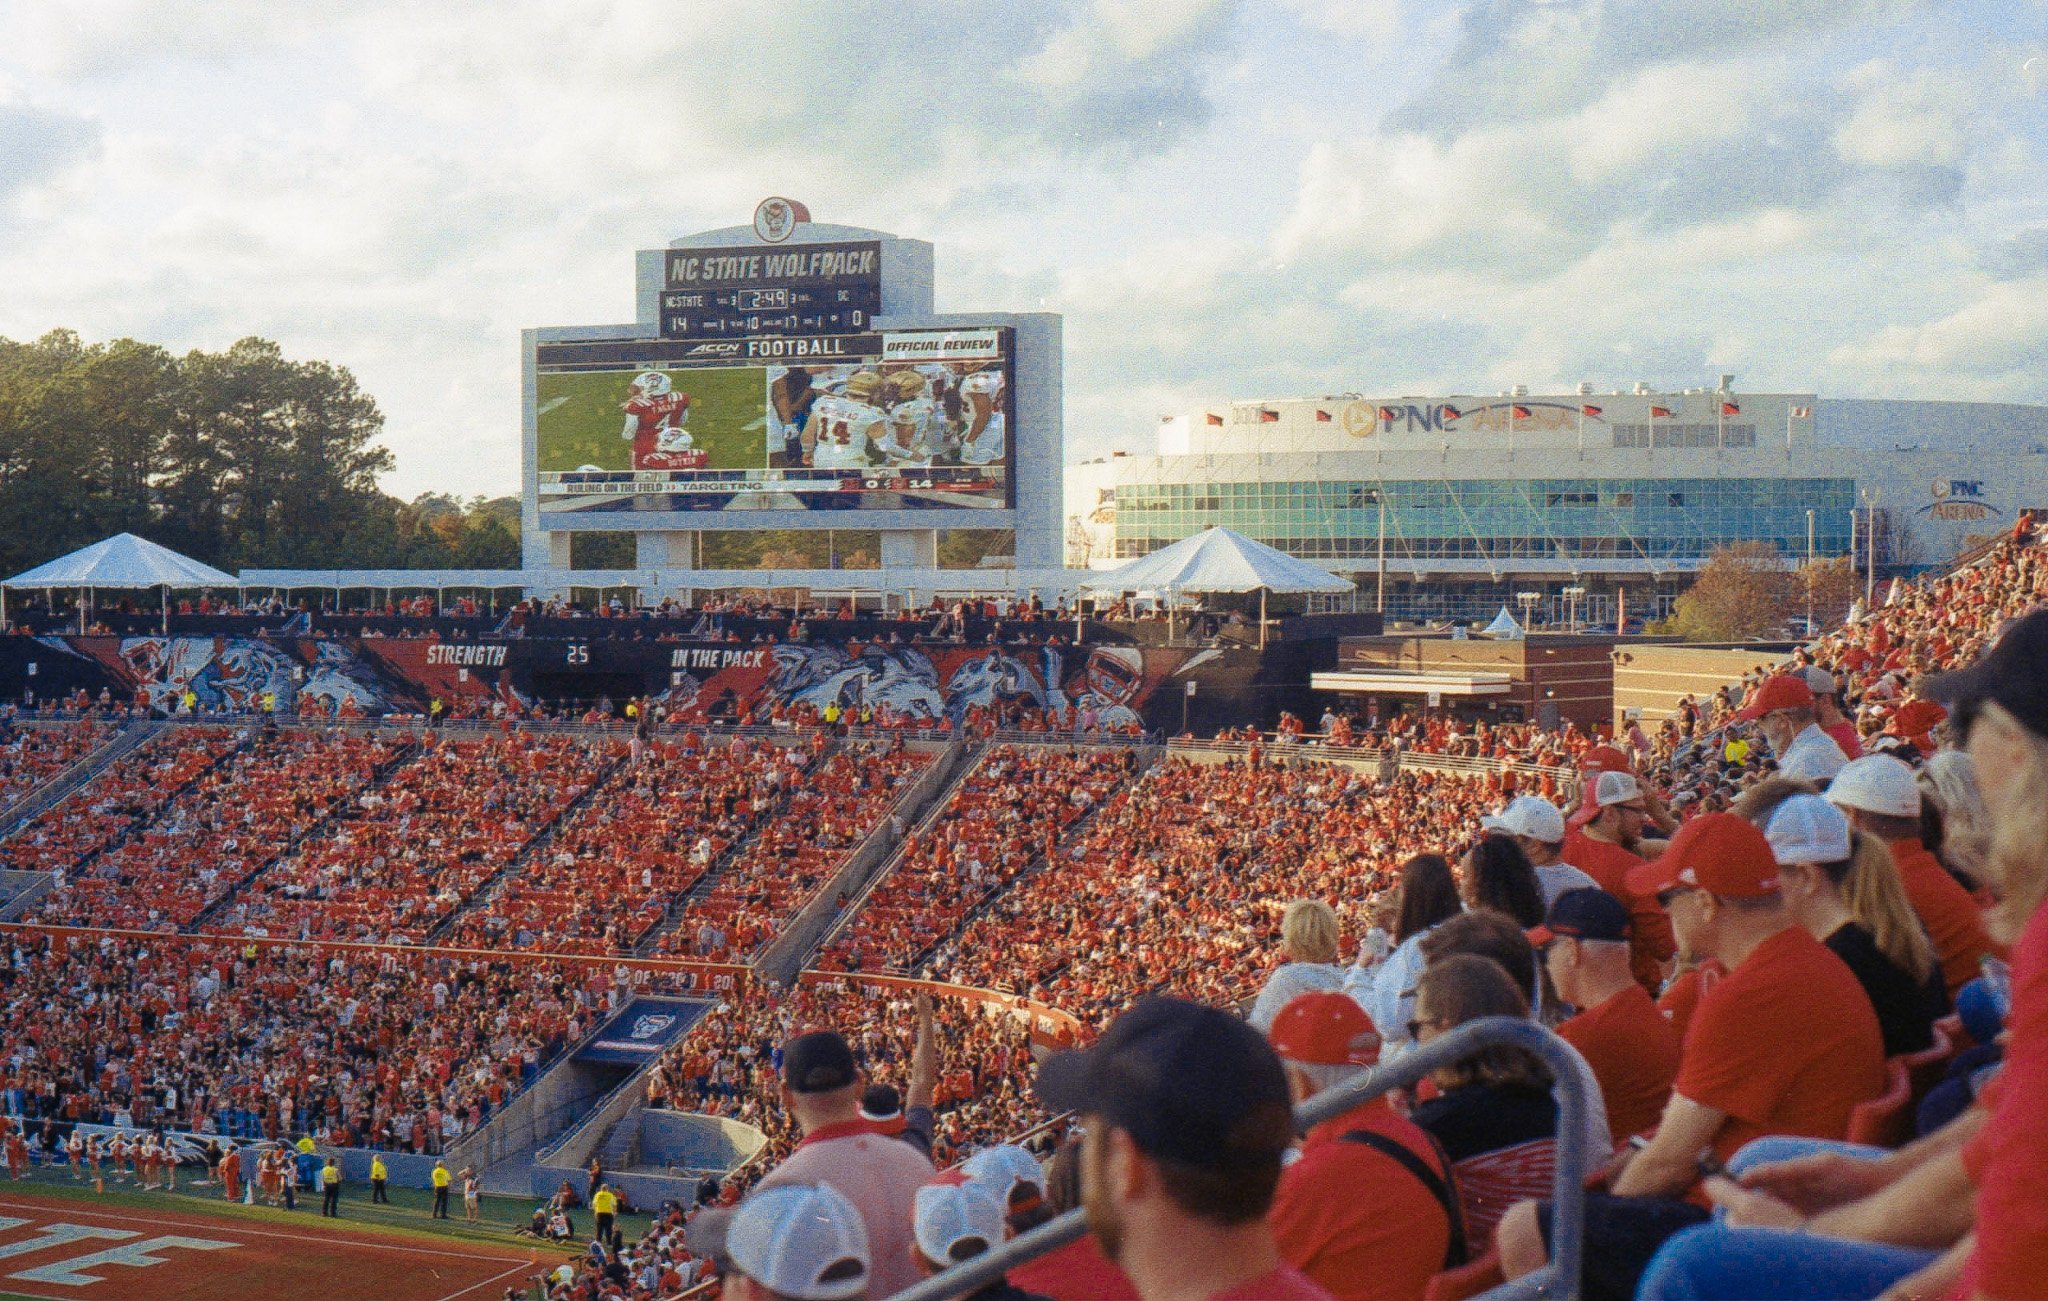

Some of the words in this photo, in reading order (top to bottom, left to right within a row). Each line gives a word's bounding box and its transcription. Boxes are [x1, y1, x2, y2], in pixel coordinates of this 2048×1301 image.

[672, 258, 699, 281] NC
[703, 255, 761, 280] STATE
[765, 251, 874, 278] WOLFPACK
[752, 291, 785, 308] 2:49
[672, 317, 687, 331] 14
[747, 316, 759, 330] 10
[785, 315, 798, 329] 17
[852, 310, 862, 326] 0
[748, 338, 845, 357] FOOTBALL
[887, 341, 940, 352] OFFICIAL
[944, 339, 994, 351] REVIEW
[1379, 404, 1461, 432] PNC
[567, 483, 602, 493] RULING
[604, 483, 618, 492] ON
[620, 483, 637, 492] THE
[638, 482, 663, 492] FIELD
[682, 482, 763, 491] TARGETING
[866, 479, 879, 489] 0
[909, 479, 933, 489] 14
[1951, 480, 1984, 496] PNC
[426, 644, 507, 666] STRENGTH
[567, 645, 589, 663] 25
[671, 649, 689, 668] IN
[691, 649, 721, 668] THE
[722, 650, 765, 668] PACK
